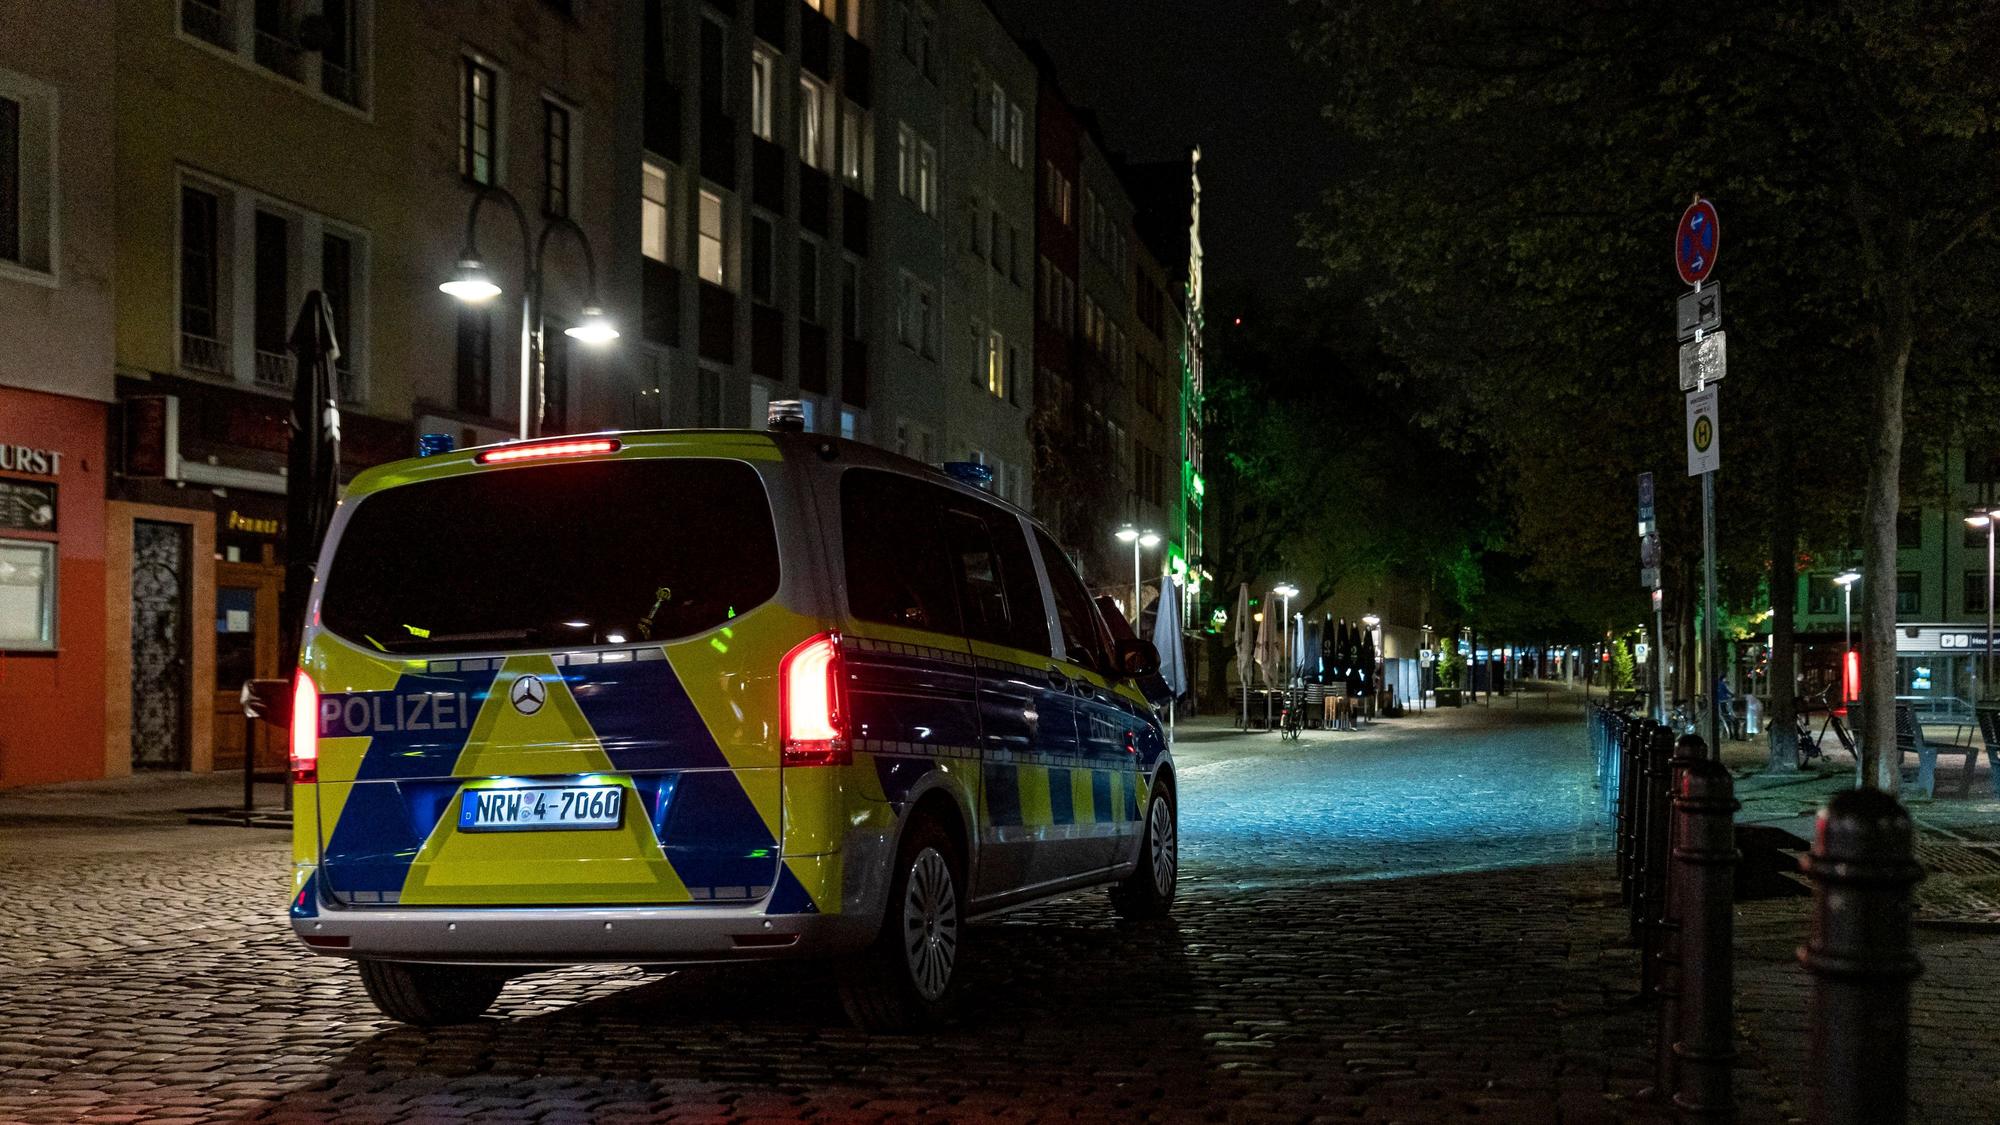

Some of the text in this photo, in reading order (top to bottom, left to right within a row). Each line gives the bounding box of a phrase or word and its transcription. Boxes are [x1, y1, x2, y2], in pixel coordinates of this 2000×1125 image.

[320, 692, 468, 734] POLIZEI
[476, 793, 522, 822] NRW
[533, 790, 620, 820] 4-7060
